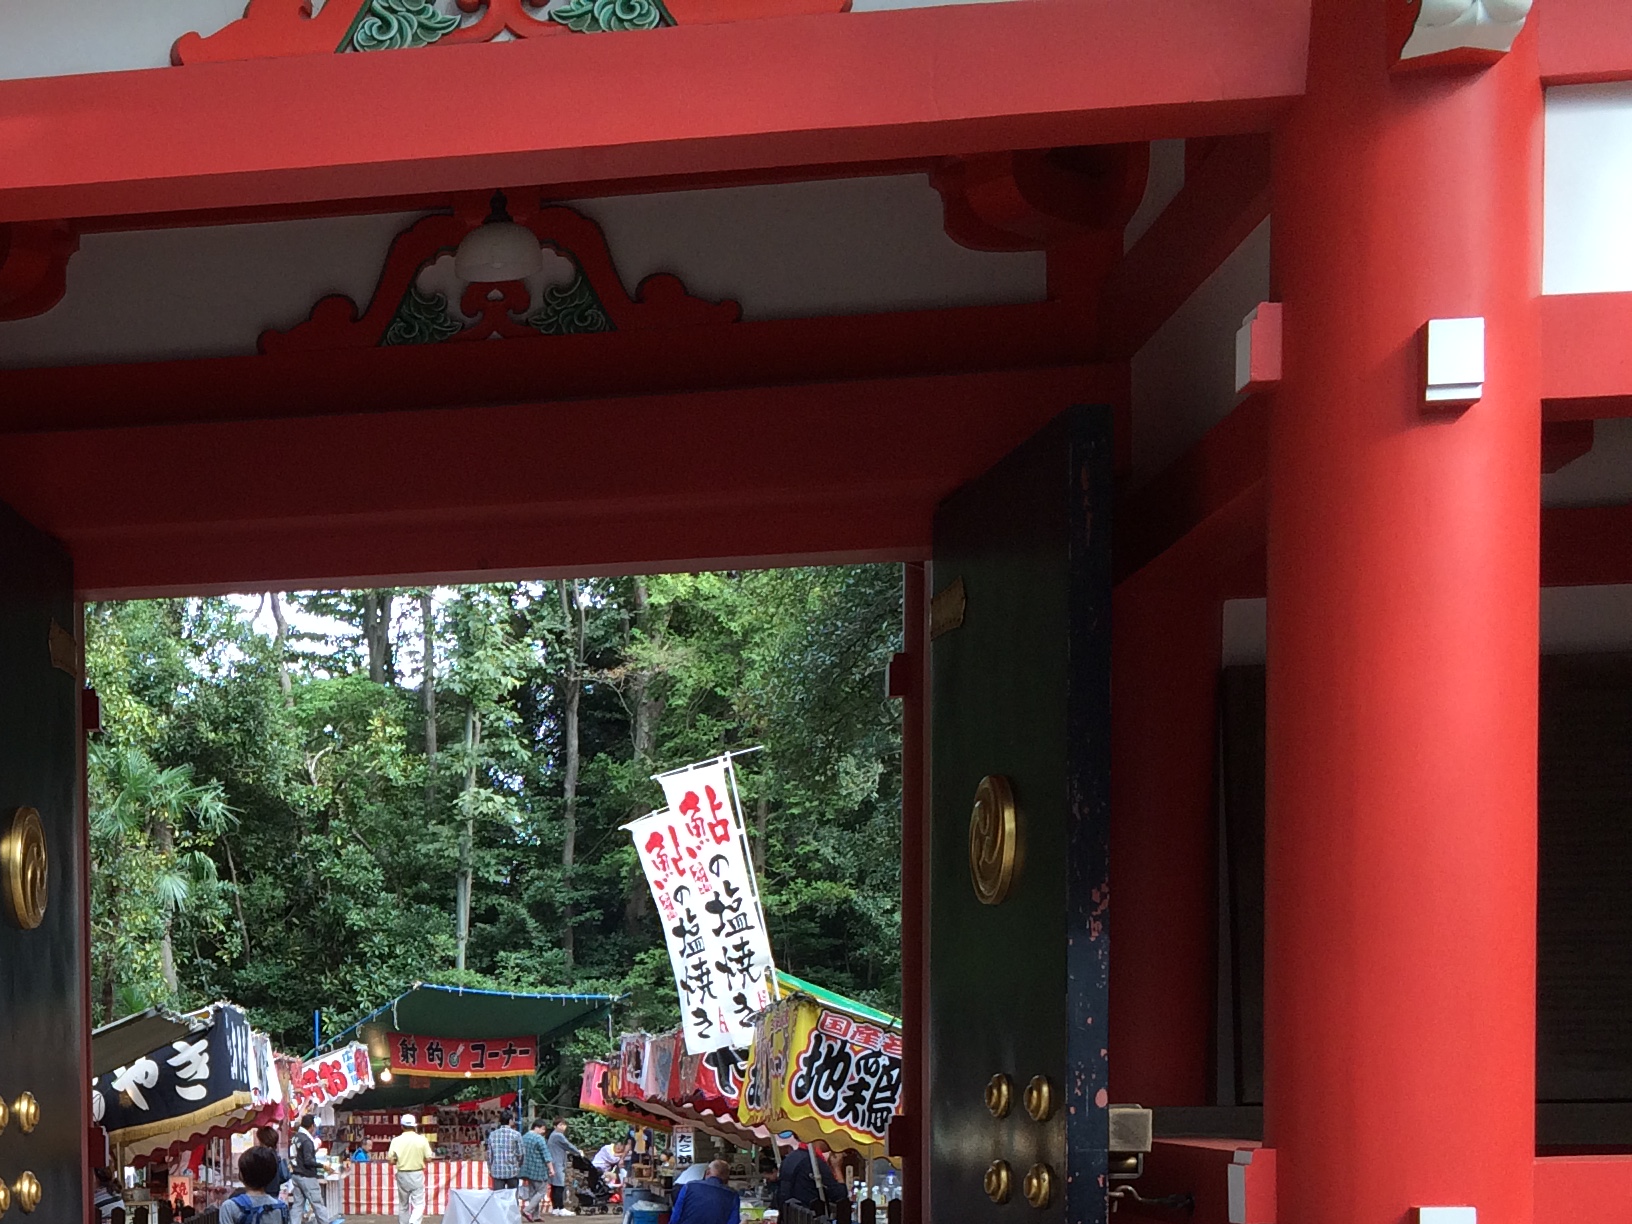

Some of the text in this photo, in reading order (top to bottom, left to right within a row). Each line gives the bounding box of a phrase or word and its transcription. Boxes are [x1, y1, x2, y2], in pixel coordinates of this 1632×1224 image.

[679, 785, 762, 1028] 鮎の塩焼き
[399, 1037, 444, 1069] 射的
[470, 1042, 531, 1070] コーナー
